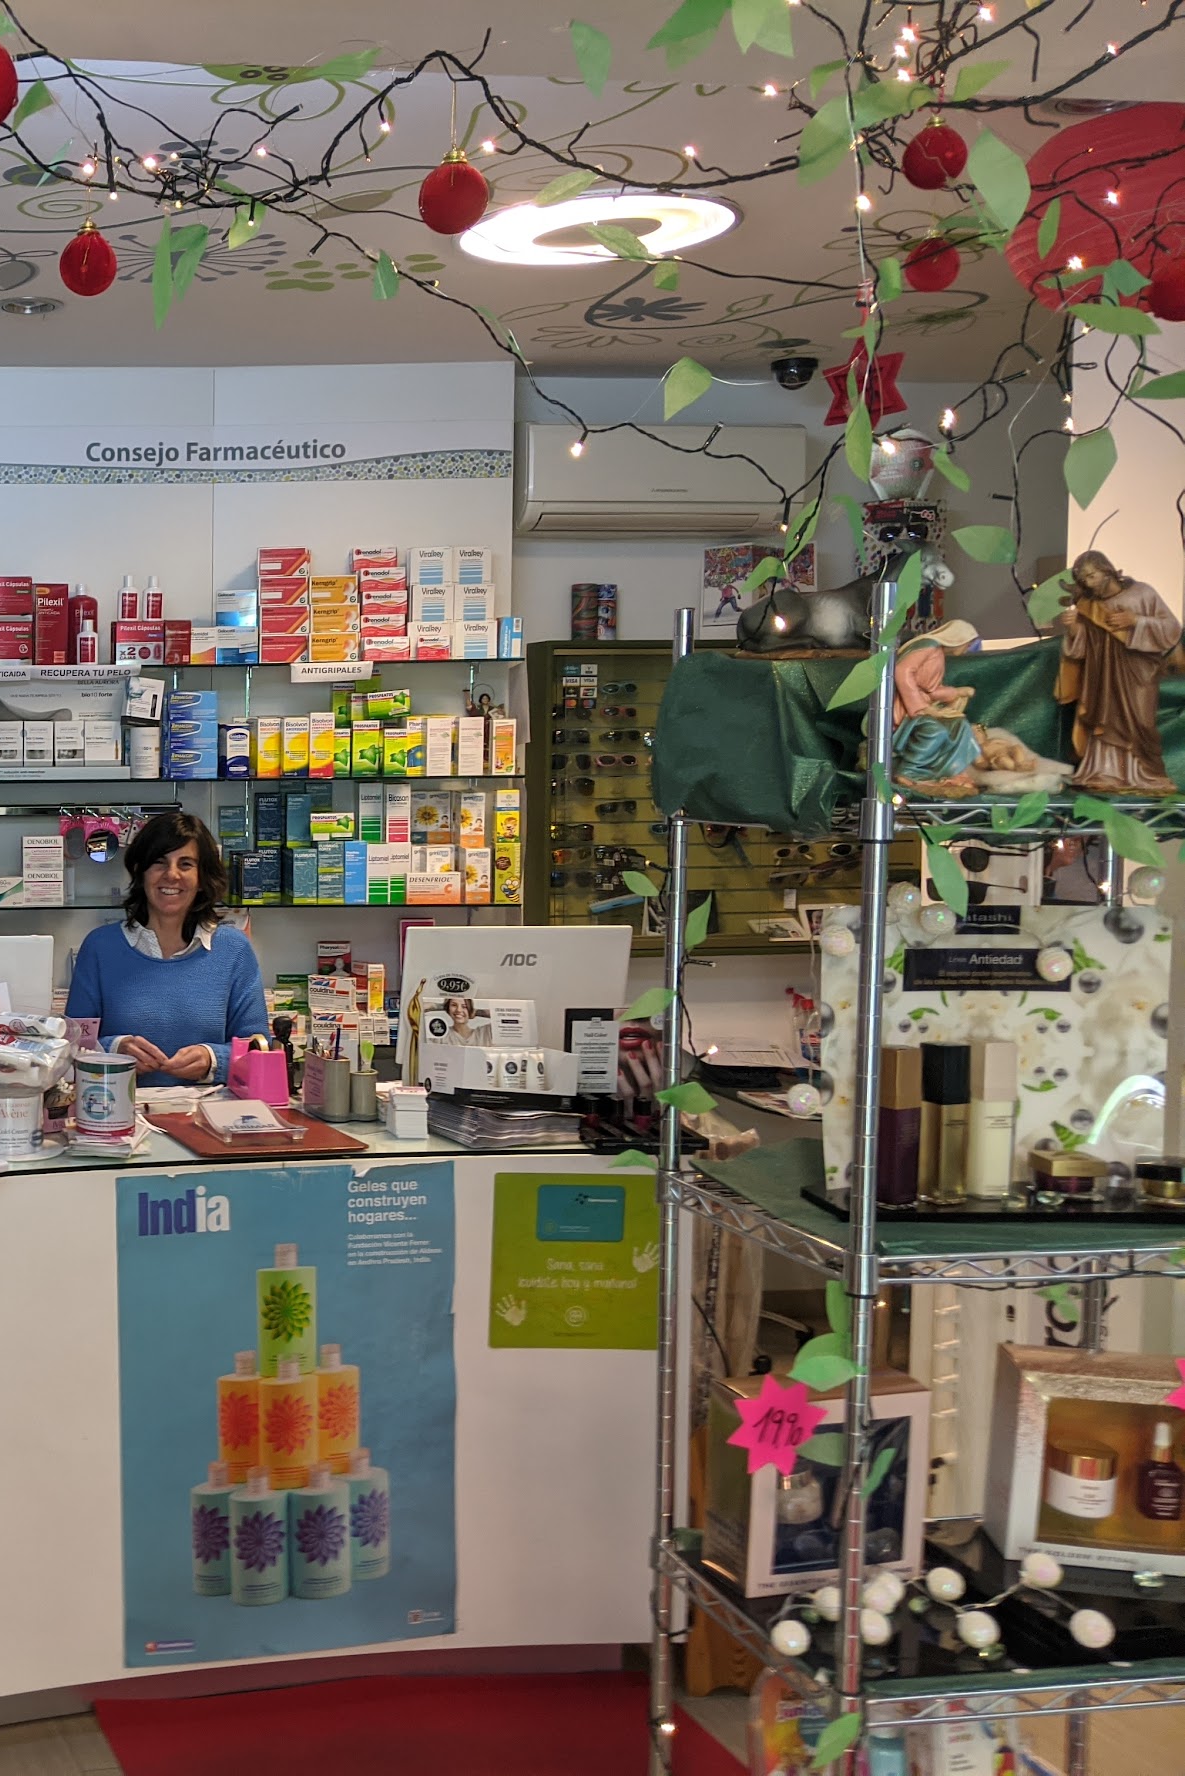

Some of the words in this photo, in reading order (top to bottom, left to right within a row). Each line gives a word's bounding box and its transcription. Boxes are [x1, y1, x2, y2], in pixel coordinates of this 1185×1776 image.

[86, 441, 179, 467] Consejo
[186, 439, 346, 462] Farmacéutico
[419, 550, 444, 559] Viralkey
[459, 550, 483, 558] Viralkey
[422, 587, 445, 596] Viralkey
[464, 587, 487, 596] Viralkey
[37, 598, 64, 607] Pilexil
[417, 625, 442, 633] Viralkey
[464, 625, 488, 633] Viralkey
[40, 669, 90, 677] RECUPERA
[107, 669, 131, 677] PELO
[500, 954, 537, 966] AOC
[969, 954, 1023, 965] Antiedad
[347, 1181, 387, 1193] Geles
[391, 1180, 418, 1193] que
[347, 1195, 427, 1208] construyen
[138, 1185, 230, 1237] India
[347, 1211, 417, 1225] hogares...
